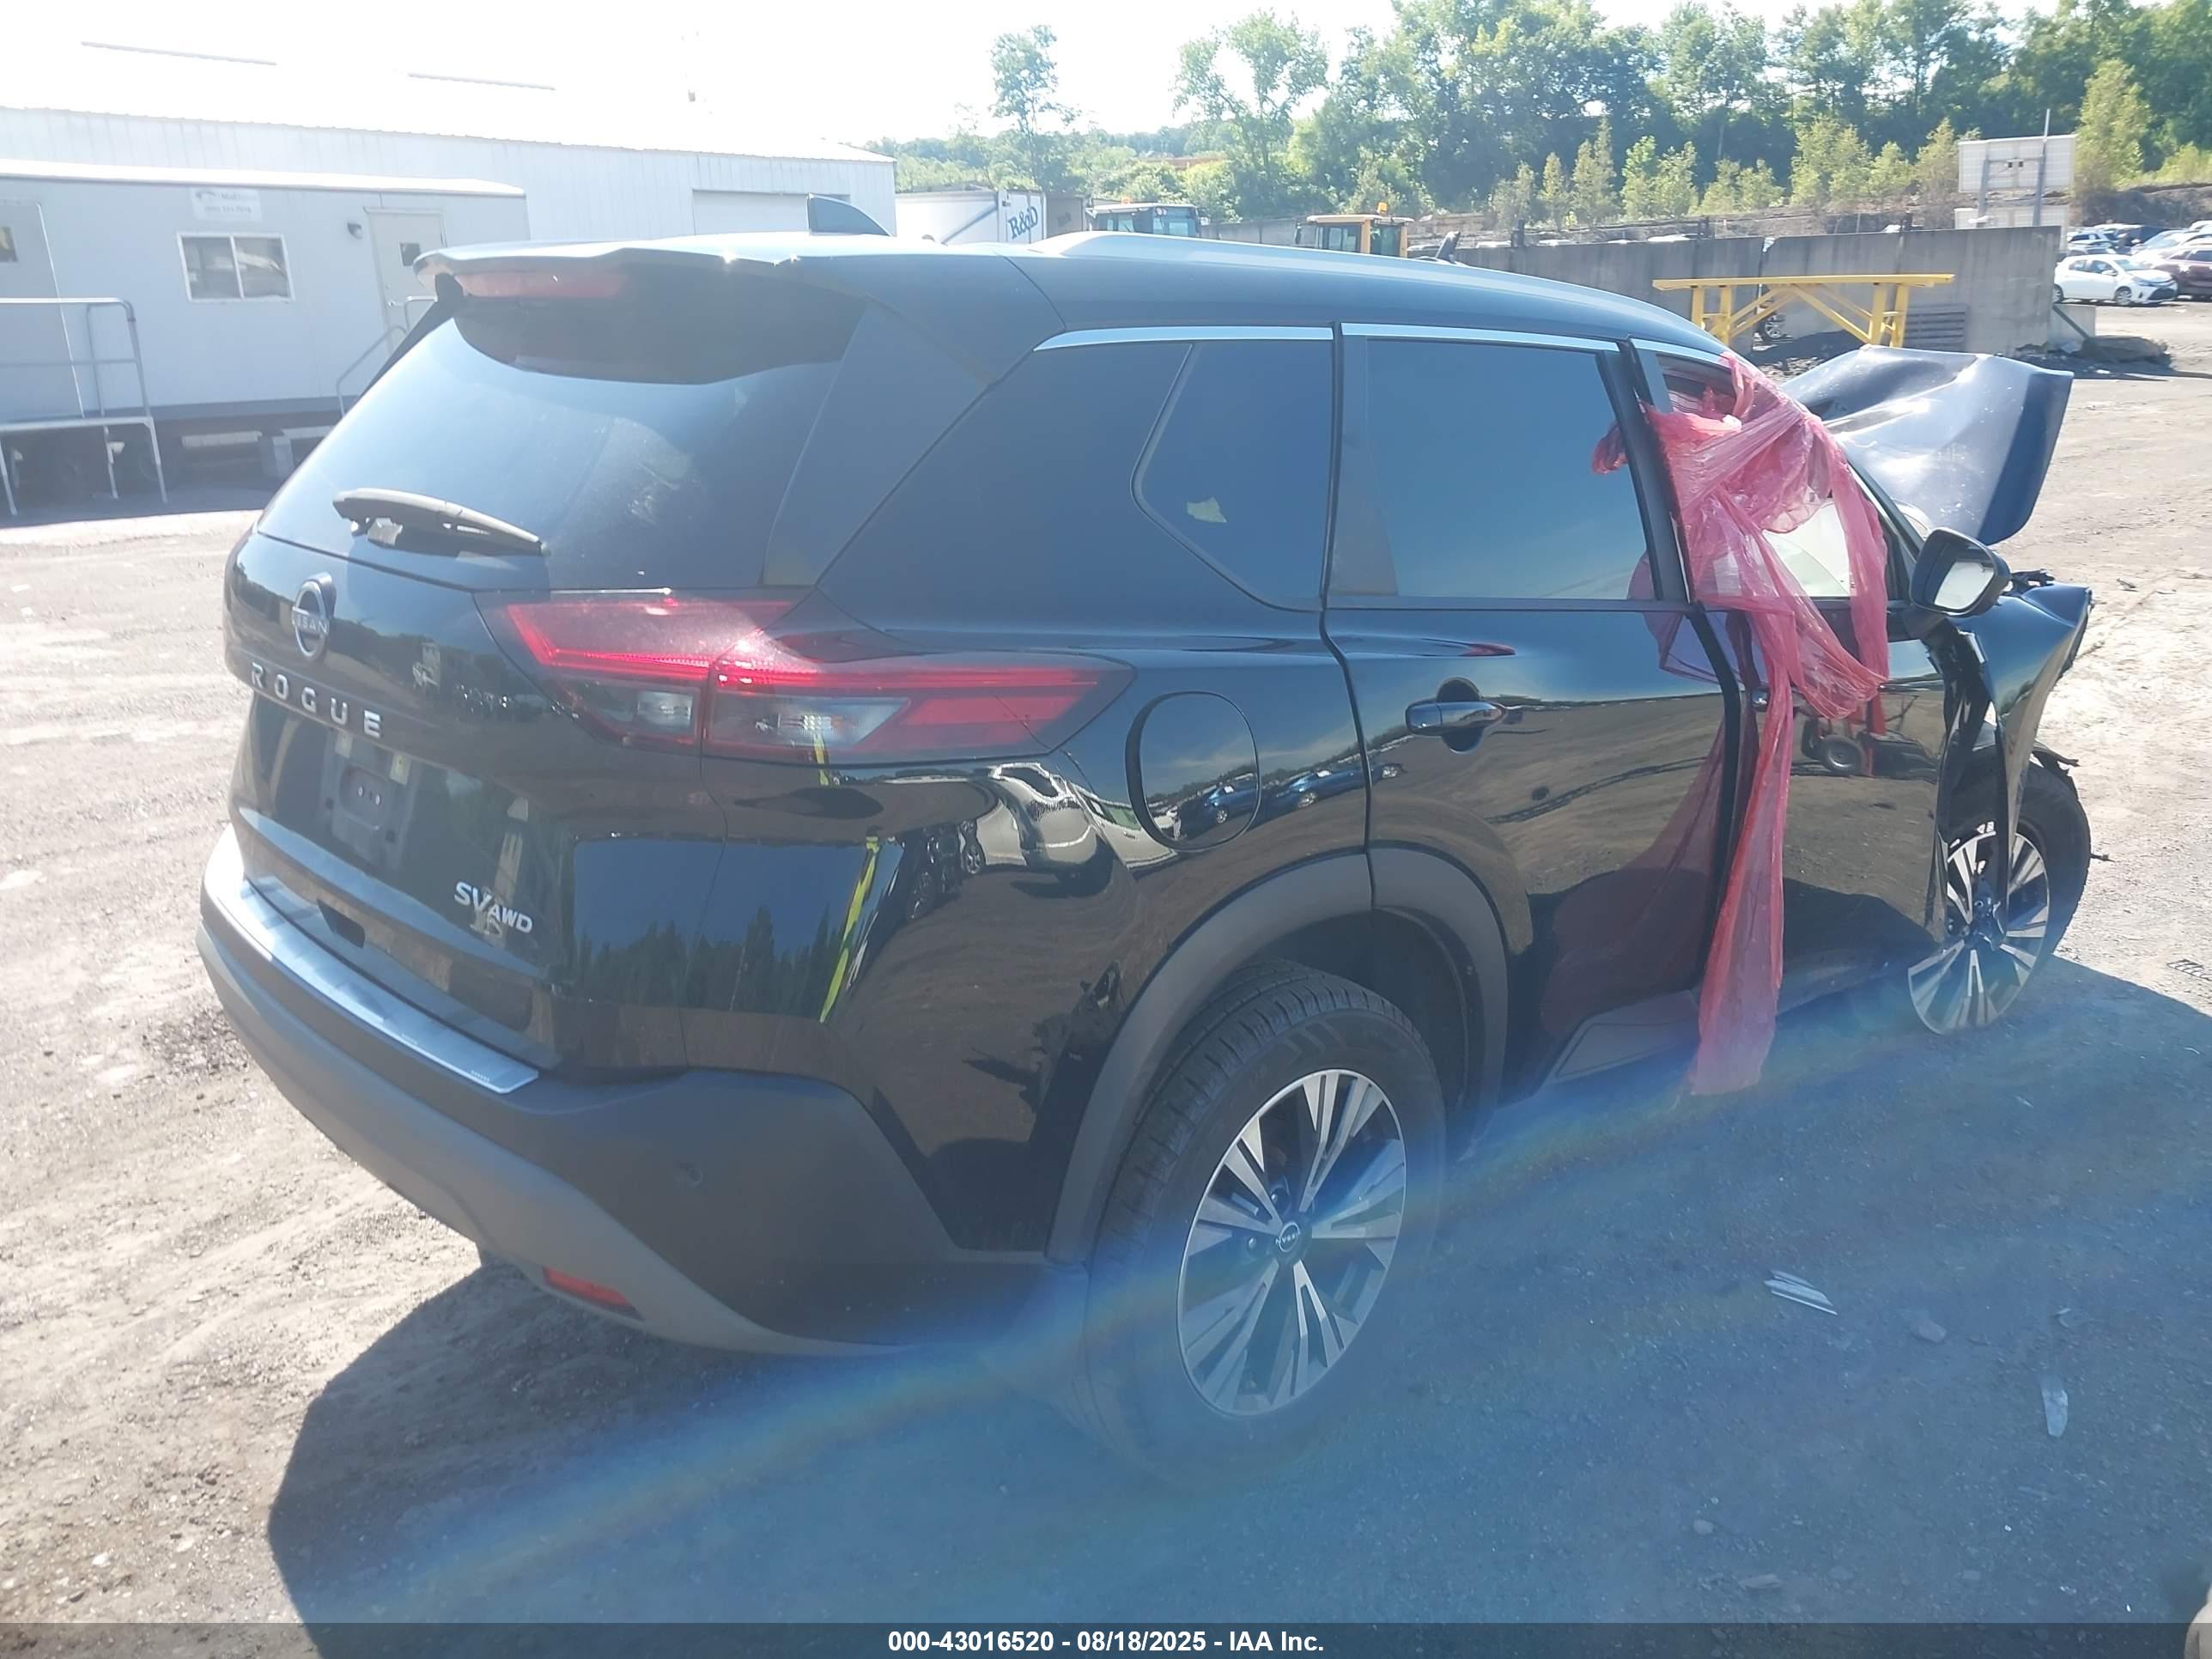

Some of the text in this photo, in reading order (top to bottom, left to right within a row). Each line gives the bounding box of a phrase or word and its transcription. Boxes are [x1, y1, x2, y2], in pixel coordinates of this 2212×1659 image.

[1008, 206, 1038, 239] R&D
[251, 661, 381, 738] ROGUE
[453, 881, 533, 933] SV AWD
